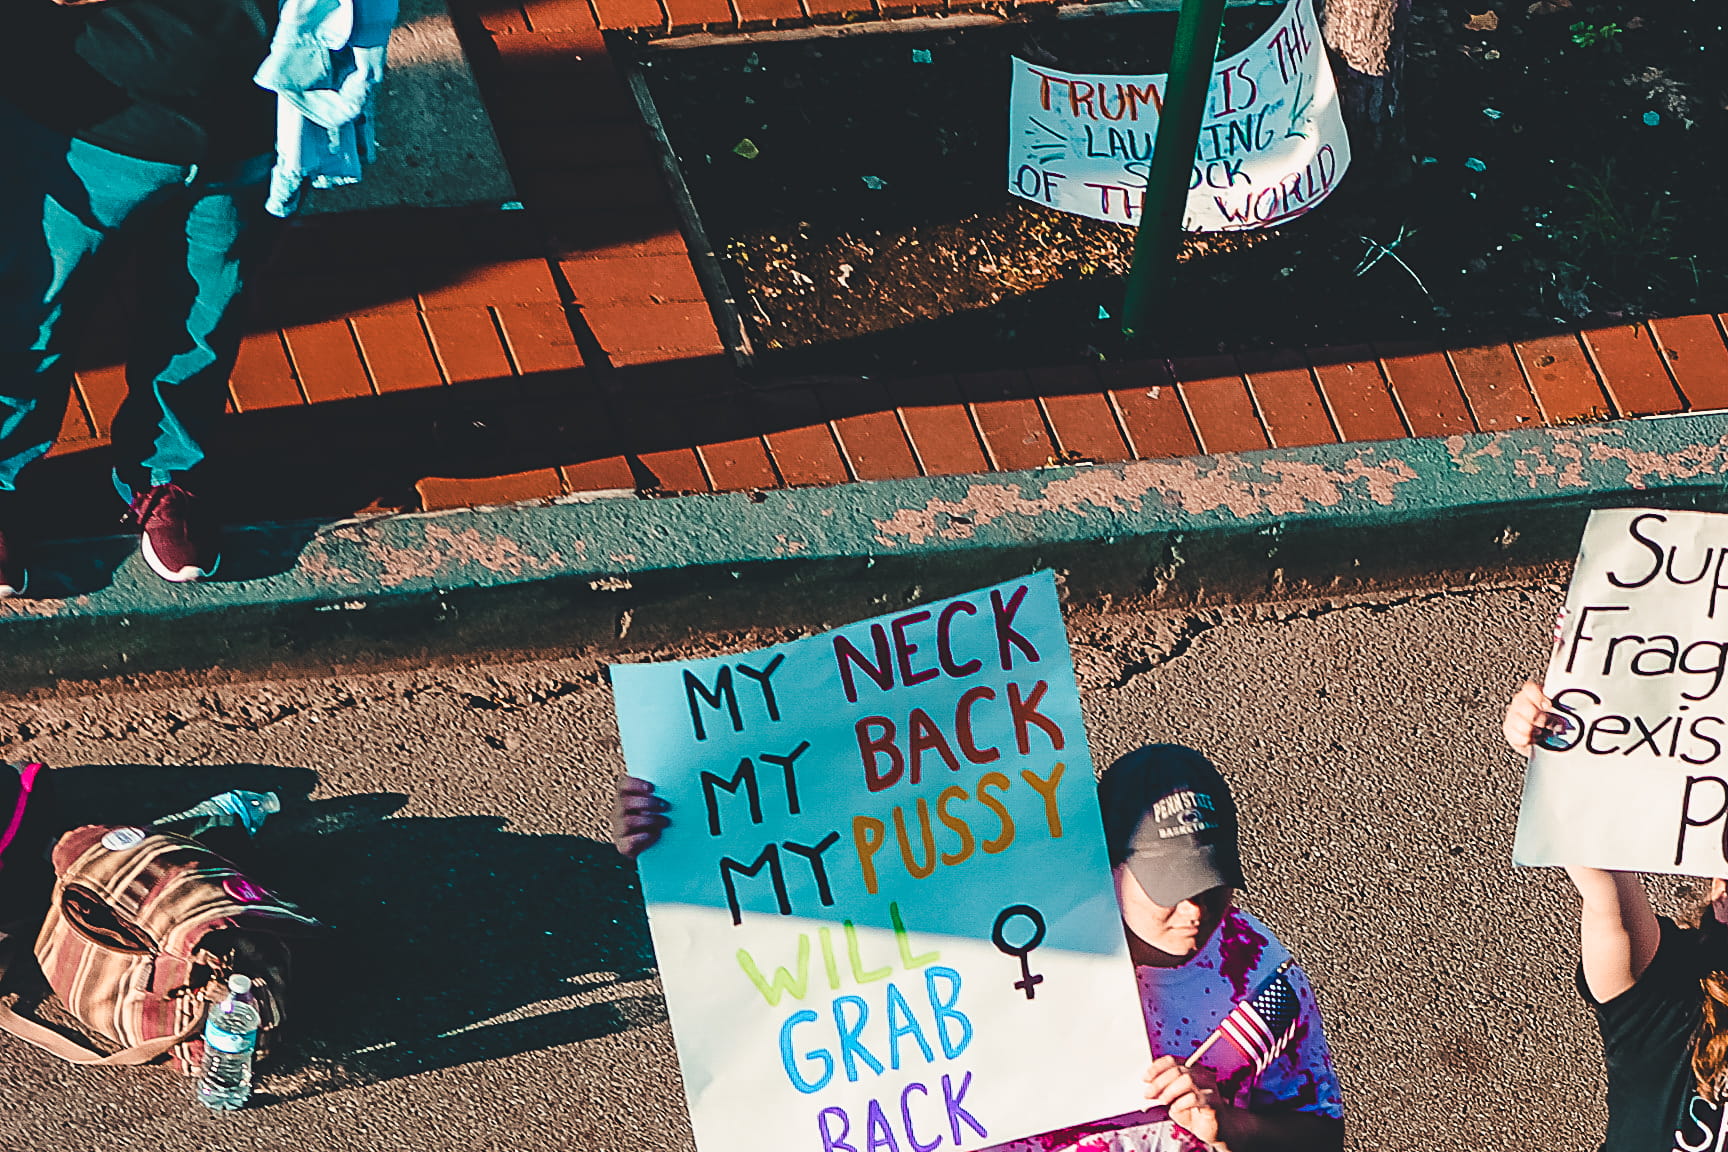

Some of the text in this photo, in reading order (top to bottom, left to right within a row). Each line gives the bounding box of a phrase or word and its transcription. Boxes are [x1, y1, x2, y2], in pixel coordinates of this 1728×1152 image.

[1027, 67, 1164, 122] TRUM
[1213, 58, 1258, 119] IS
[1013, 144, 1337, 223] OF TH WORLD
[682, 584, 1040, 741] MY NECK
[699, 678, 1066, 836] MY BACK
[718, 761, 1067, 926] MY PUSSY
[735, 900, 941, 1007] WILL
[778, 965, 974, 1095] GRAB
